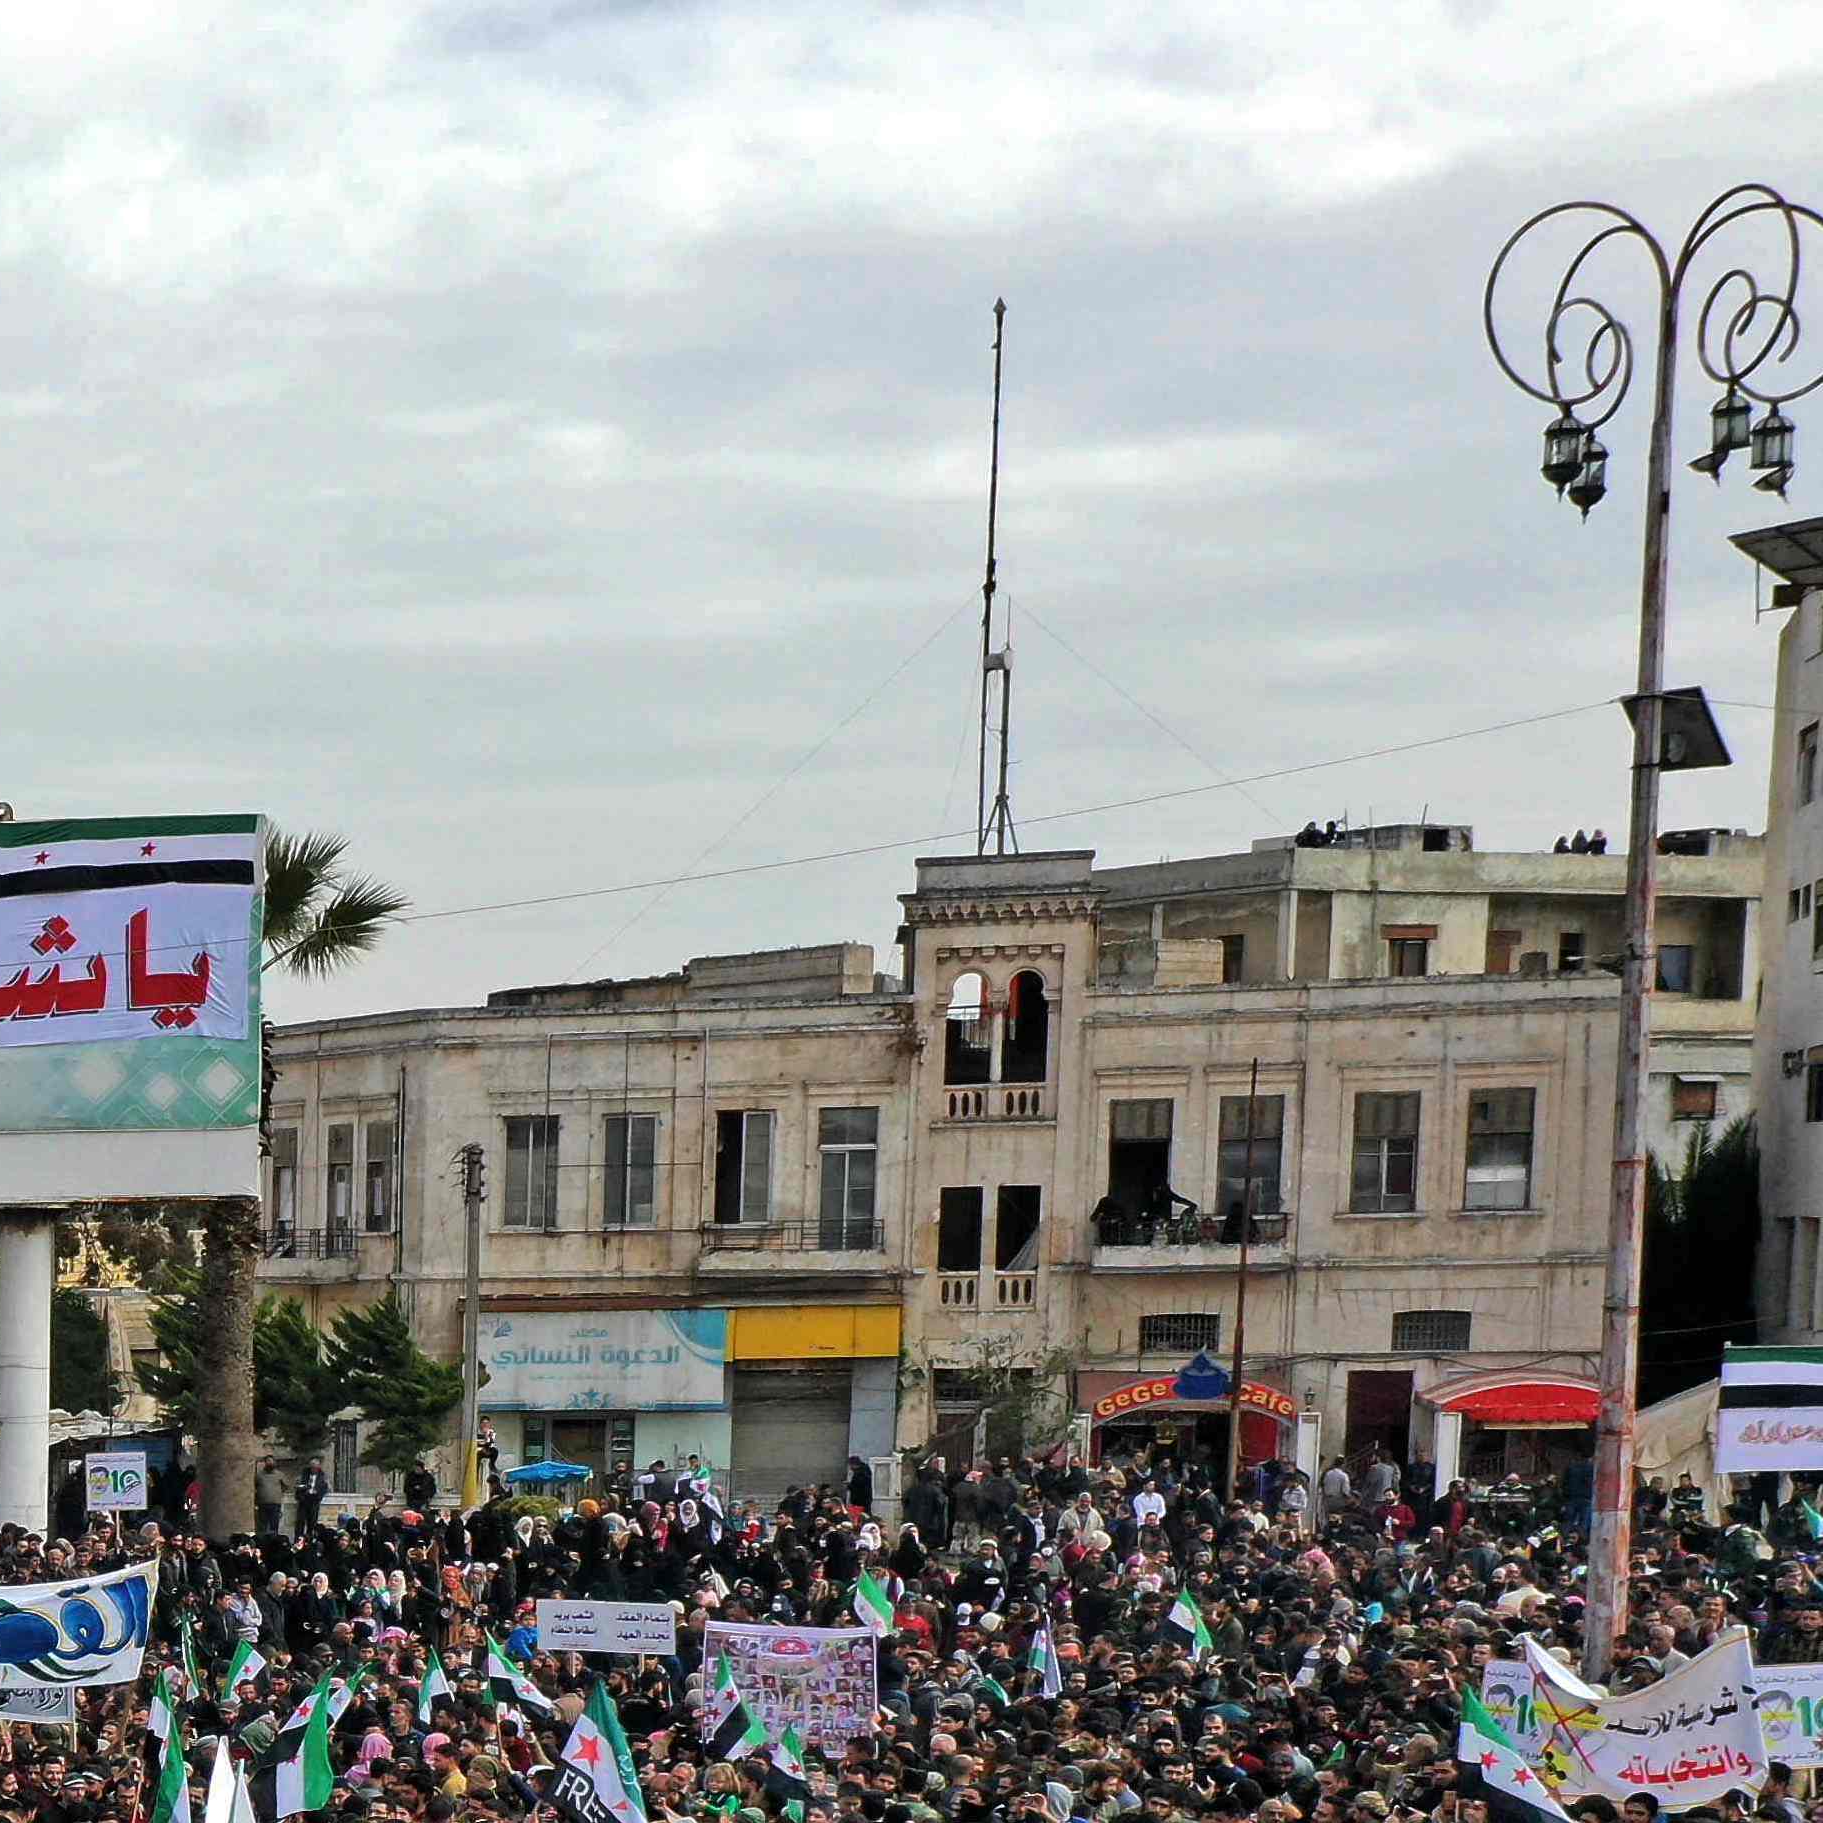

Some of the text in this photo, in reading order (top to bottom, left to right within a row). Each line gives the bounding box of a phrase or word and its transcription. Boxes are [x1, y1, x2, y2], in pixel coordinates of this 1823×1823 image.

[125, 907, 210, 1030] يا
[492, 1346, 680, 1369] الدعوة النسائي
[1096, 1382, 1294, 1416] GeGe Cafe
